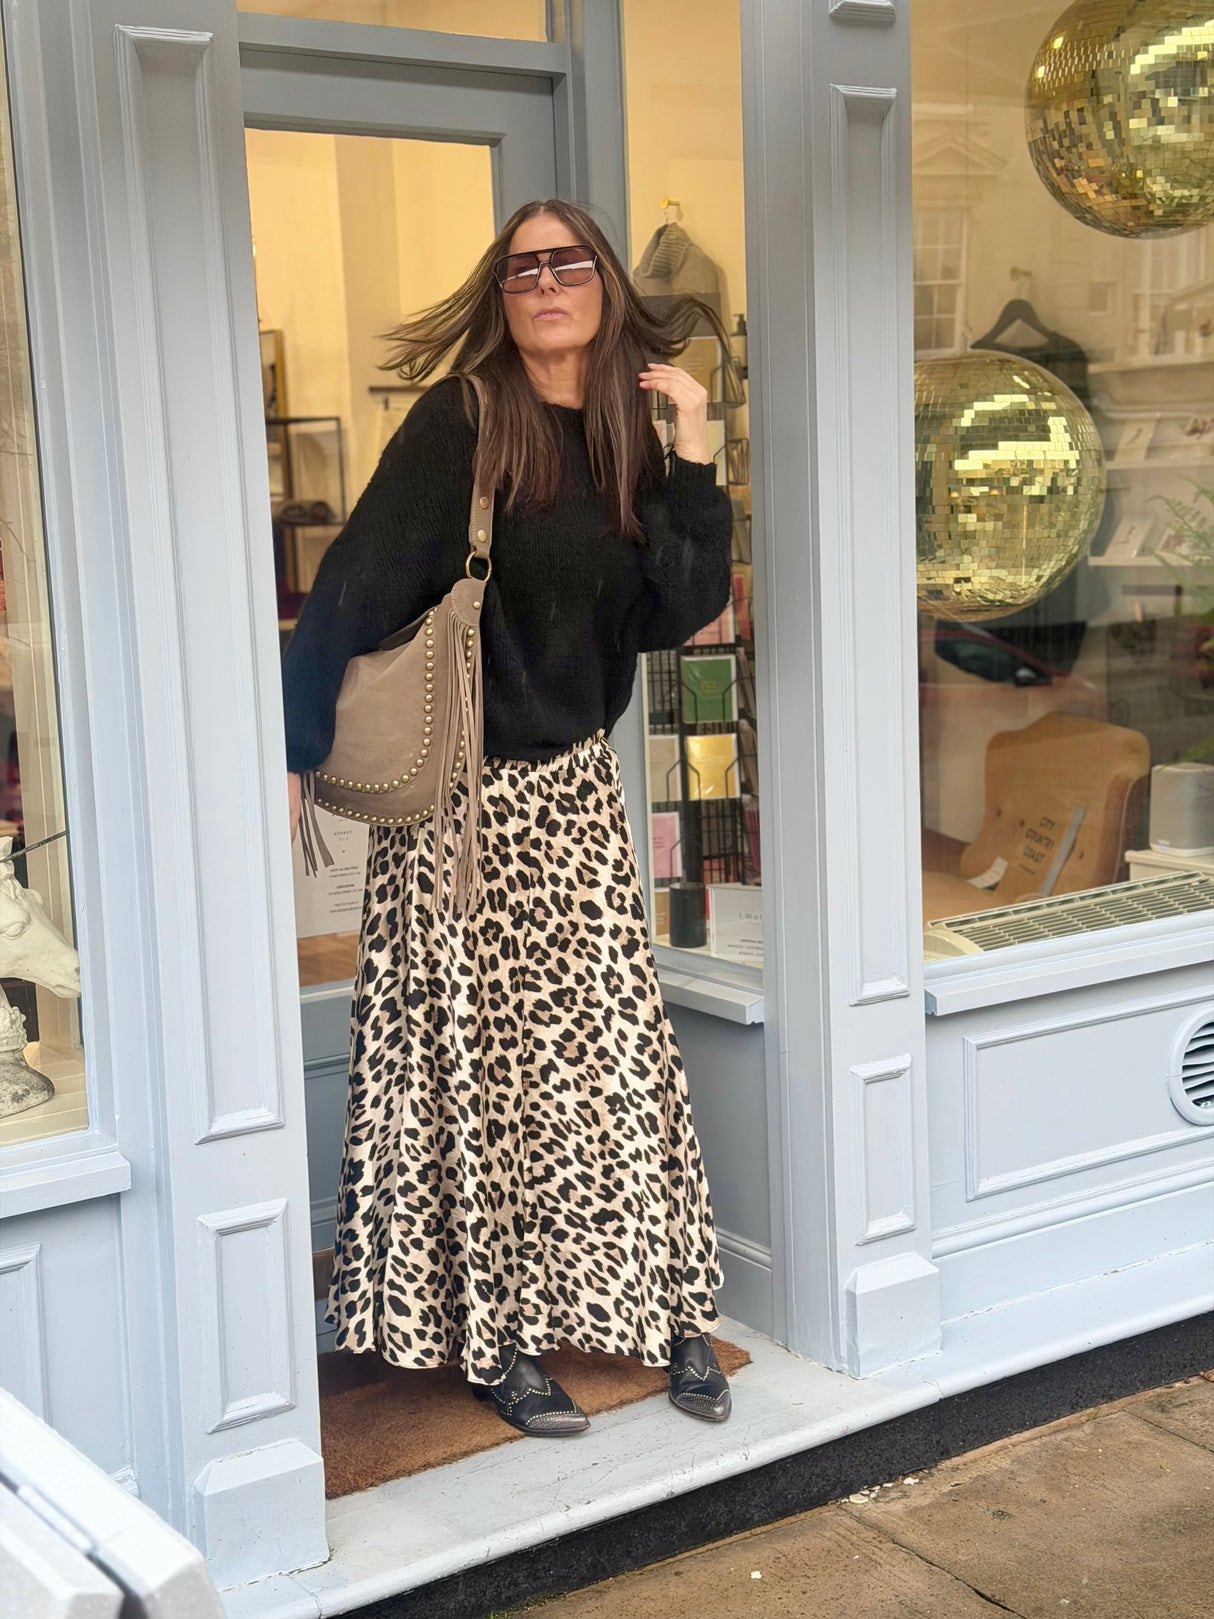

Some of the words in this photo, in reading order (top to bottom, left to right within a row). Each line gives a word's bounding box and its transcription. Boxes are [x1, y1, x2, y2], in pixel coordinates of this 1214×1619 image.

[1039, 815, 1056, 832] CITY
[1025, 828, 1056, 851] COUNTRY
[1023, 846, 1045, 864] COAST
